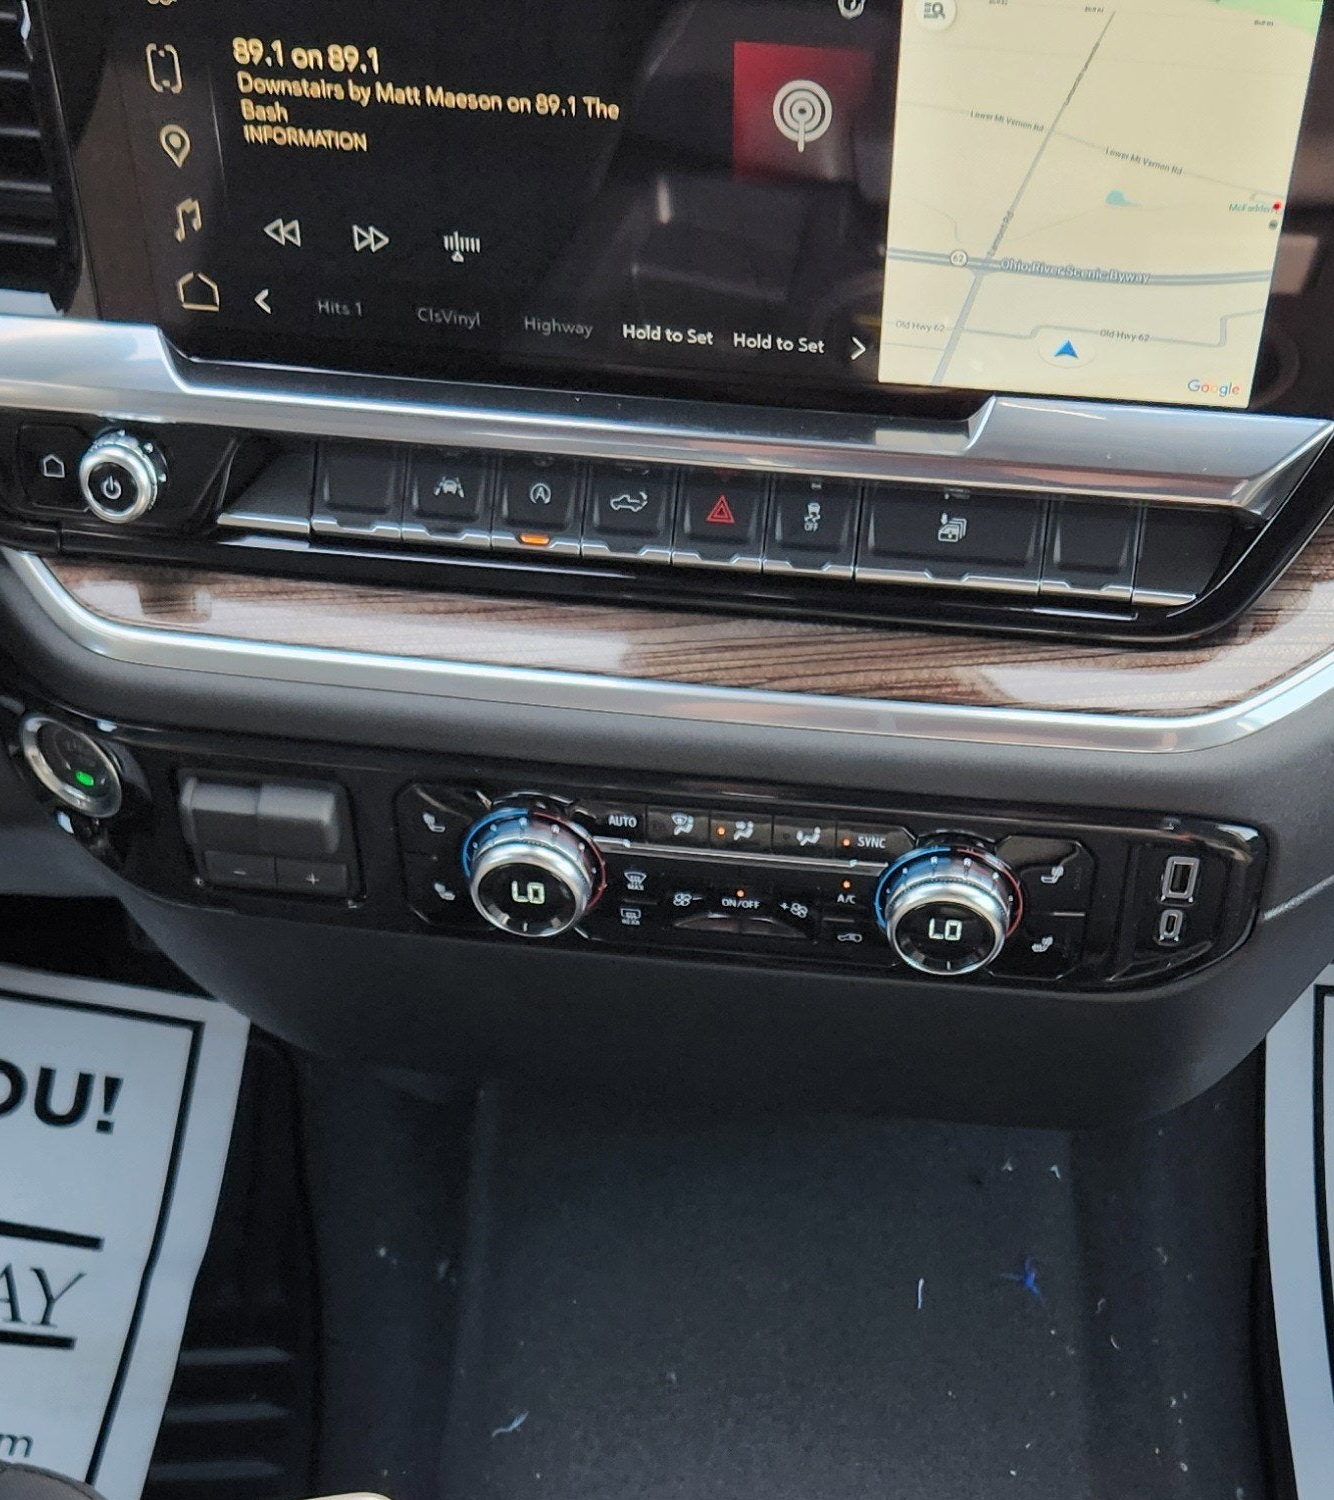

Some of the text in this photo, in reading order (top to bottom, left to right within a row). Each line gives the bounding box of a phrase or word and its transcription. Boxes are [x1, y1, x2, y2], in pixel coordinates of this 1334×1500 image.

[232, 36, 379, 75] 89.1 on 89.1
[237, 70, 620, 121] Downstairs by Matt Maeson on 89.1 The
[241, 98, 289, 124] Bash
[243, 124, 368, 152] INFORMATION
[1001, 257, 1151, 286] Ohio River Scenic Byway
[317, 299, 363, 317] Hits 1
[523, 316, 594, 339] Highway
[622, 323, 714, 347] Hold to Set
[896, 319, 946, 335] Old Hwy 62
[1100, 328, 1150, 344] Old Hwy 62
[733, 332, 825, 355] Hold to Set
[1187, 378, 1240, 397] Google
[608, 814, 638, 829] AUTO
[857, 836, 887, 850] SYNC
[722, 899, 761, 911] ON/OFF
[837, 894, 857, 905] A/C
